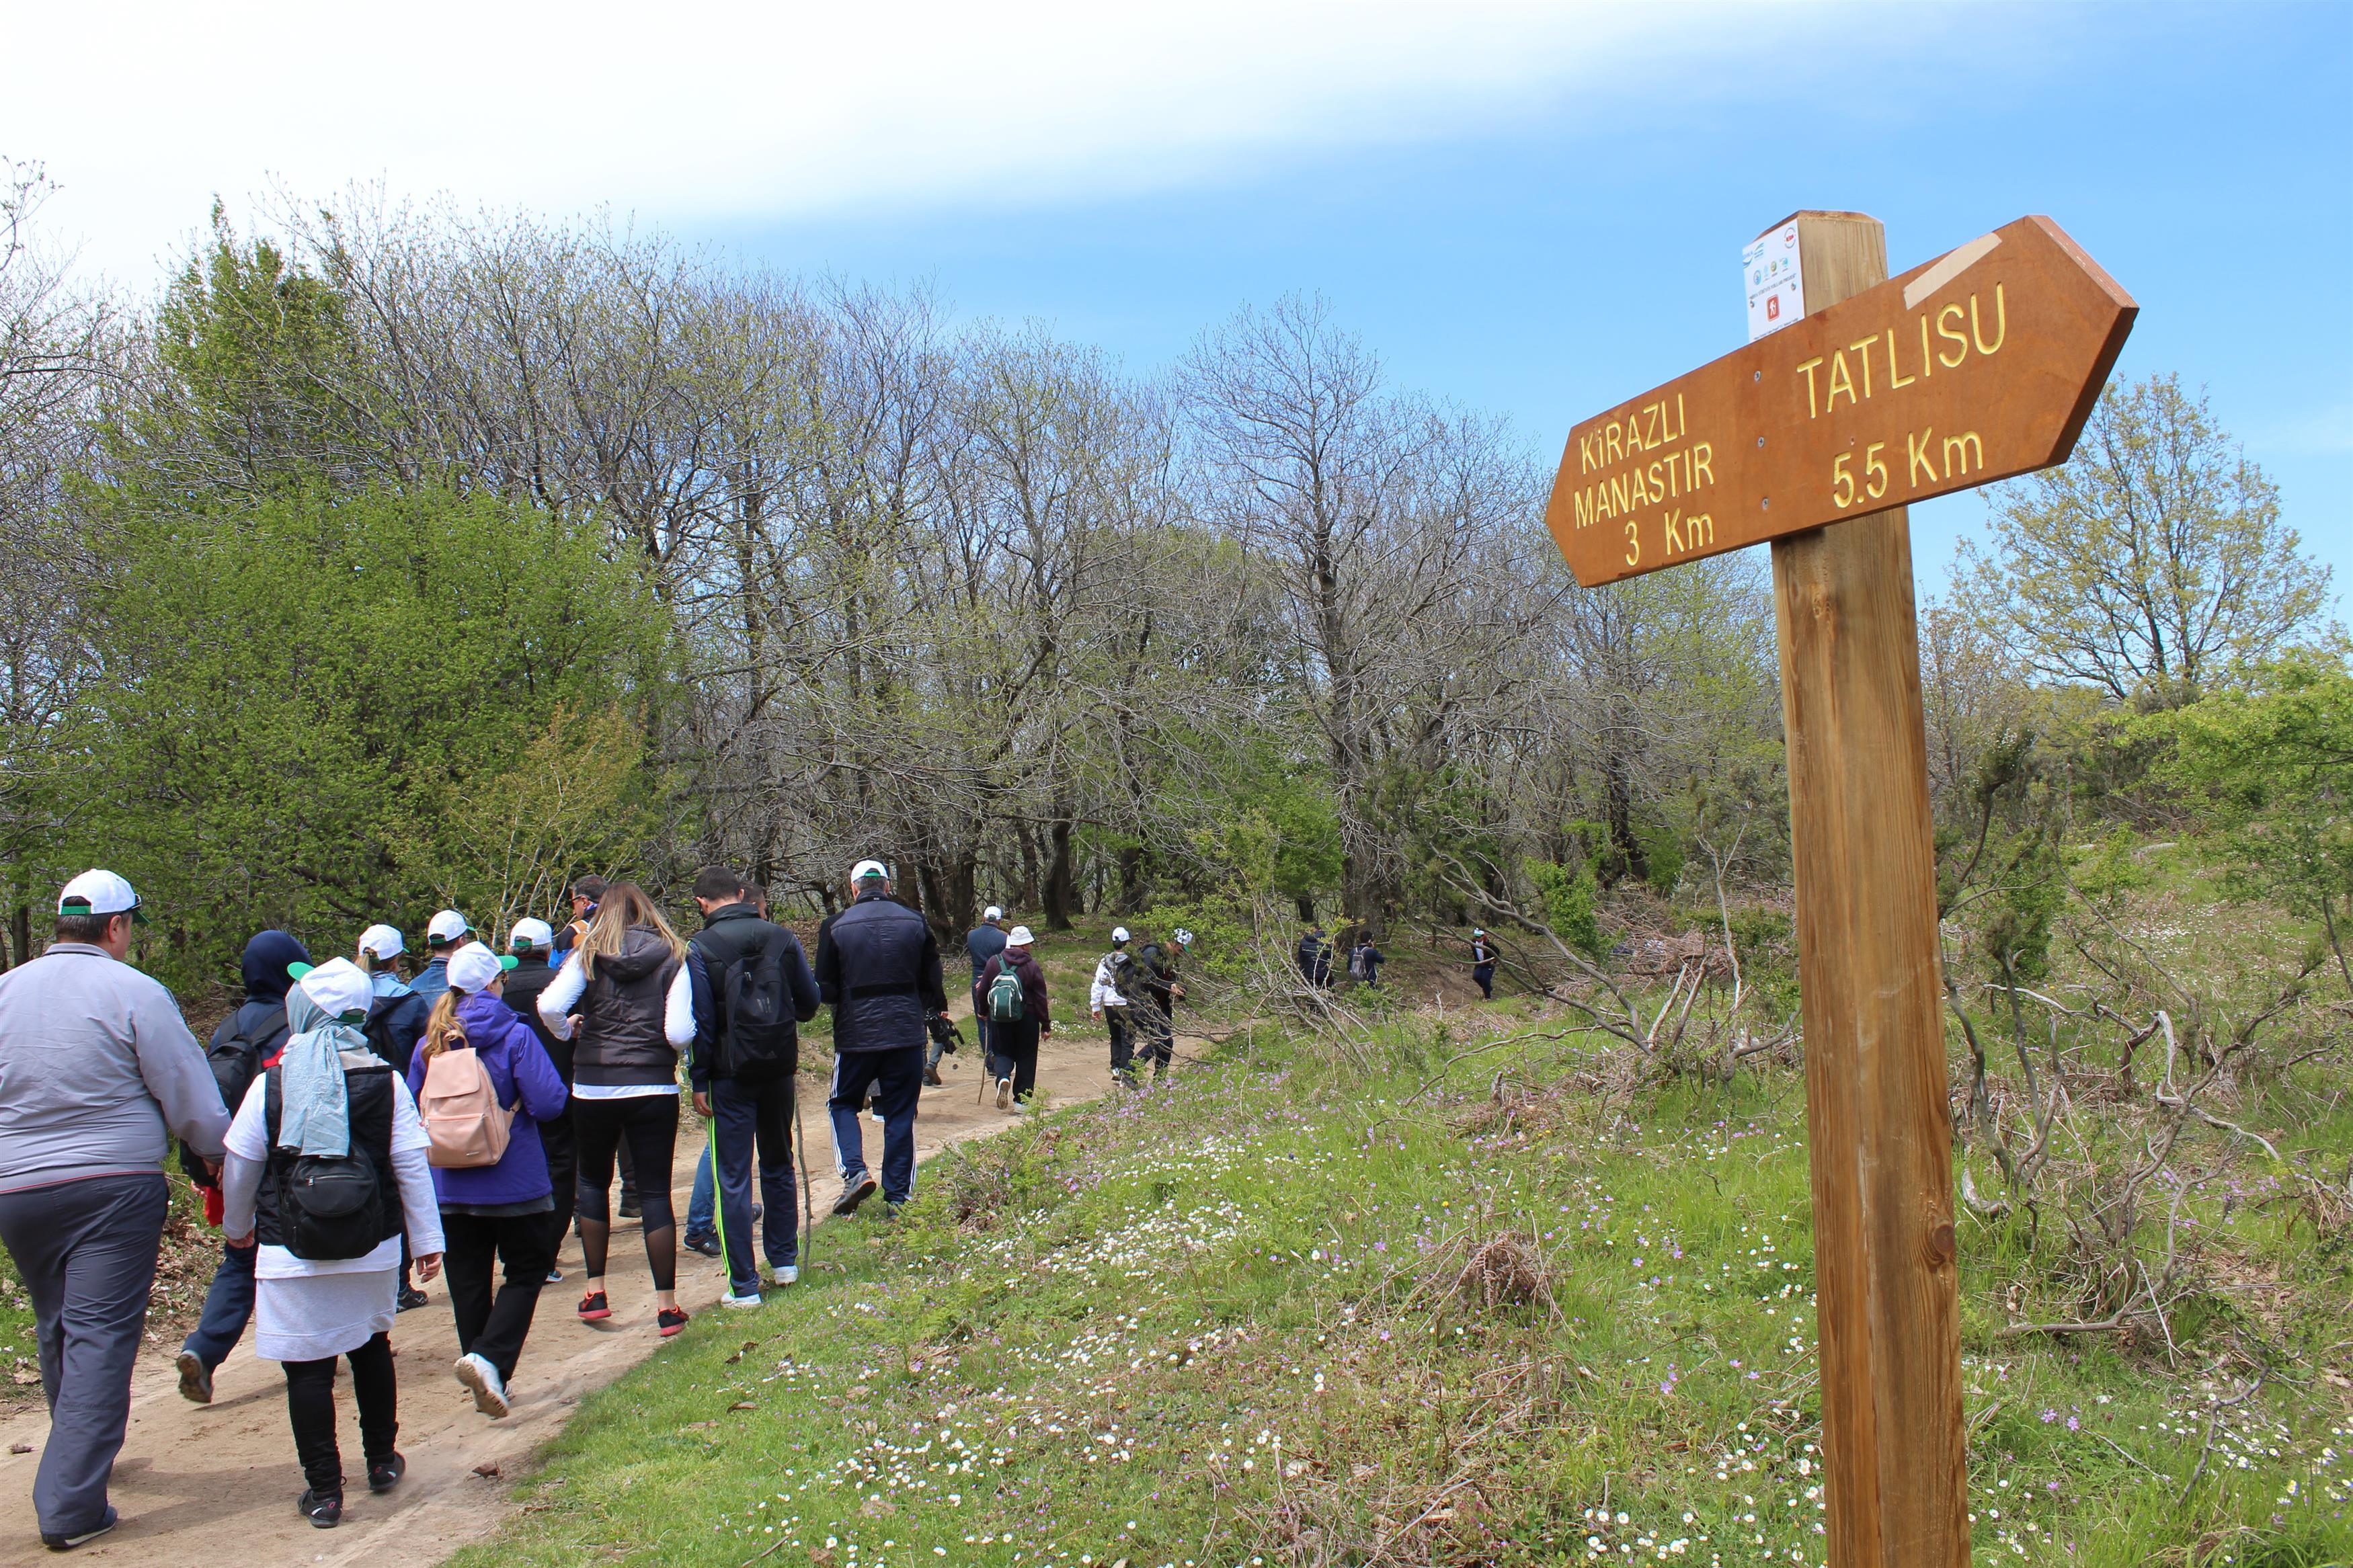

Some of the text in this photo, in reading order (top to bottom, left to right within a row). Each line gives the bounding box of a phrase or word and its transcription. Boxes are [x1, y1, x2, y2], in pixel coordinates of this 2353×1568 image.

[1796, 282, 2006, 419] TATLISU
[1574, 441, 1715, 530] MANASTIR
[1833, 426, 1984, 508] 5.5 Km
[1624, 507, 1714, 566] 3 Km
